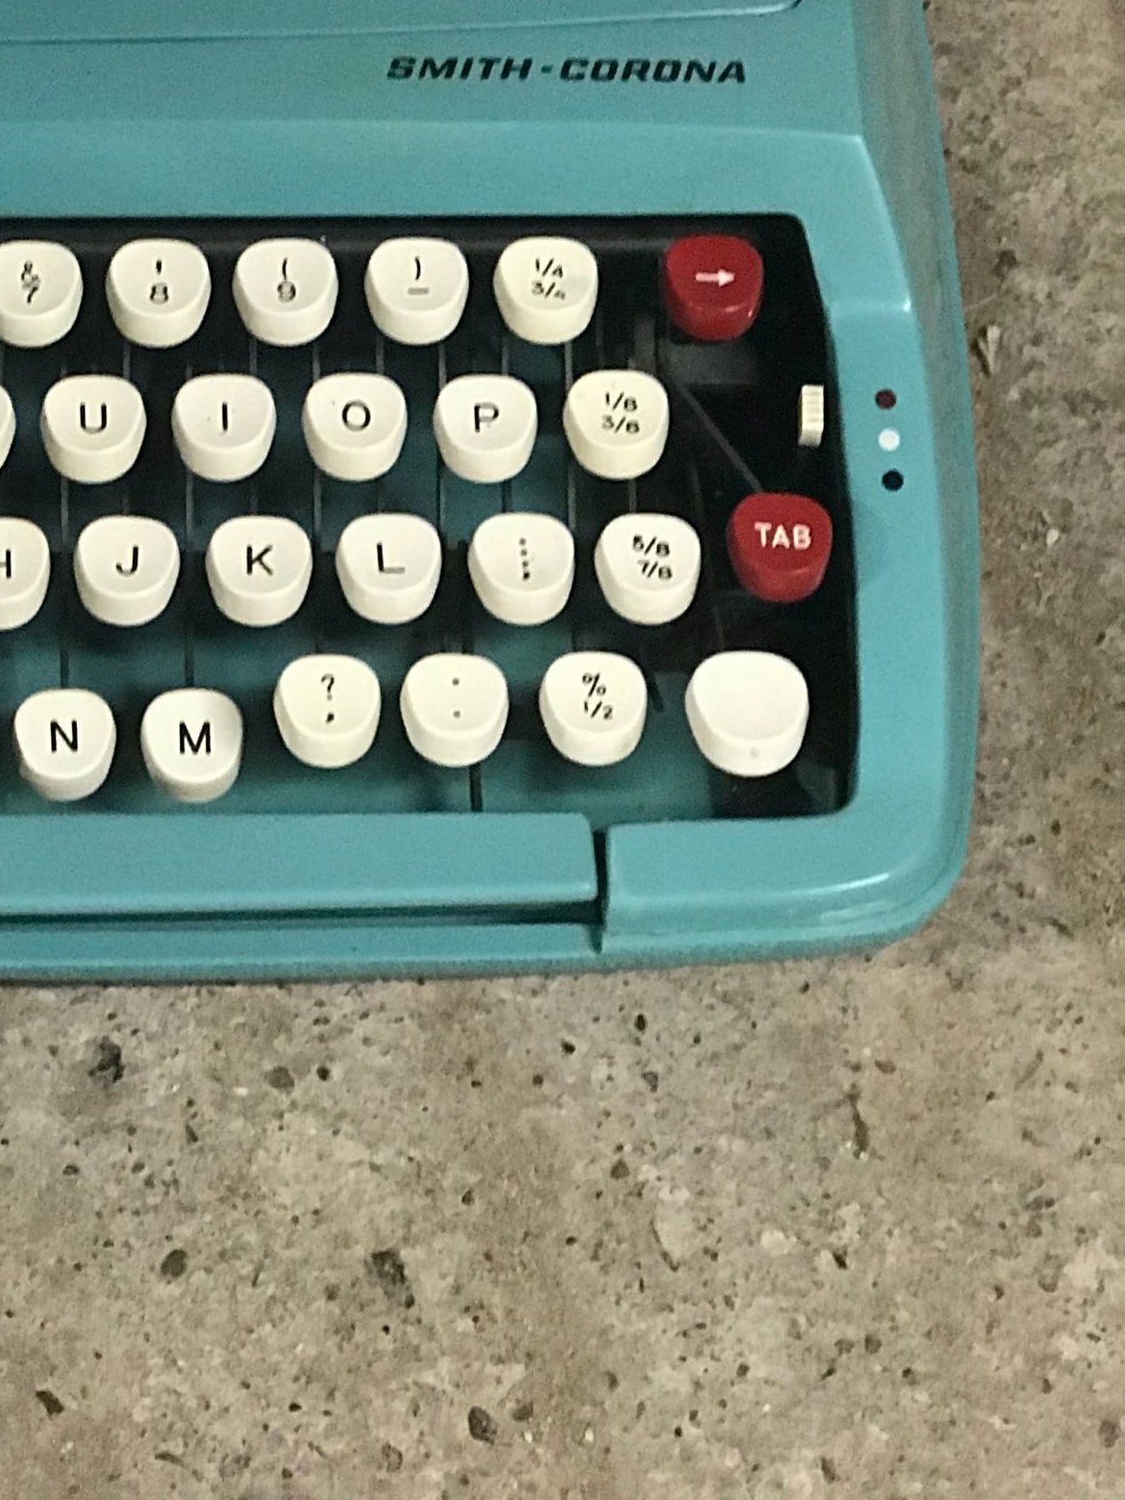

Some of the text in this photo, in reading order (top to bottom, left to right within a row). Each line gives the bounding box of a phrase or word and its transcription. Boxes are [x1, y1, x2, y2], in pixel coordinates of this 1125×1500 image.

[387, 56, 748, 84] SMITH-CORONA
[281, 257, 289, 281] (
[412, 256, 422, 281] )
[535, 258, 564, 278] 1/4
[21, 282, 40, 304] 7
[149, 281, 170, 304] 8
[277, 280, 297, 303] 9
[531, 281, 566, 300] 3/4
[79, 401, 108, 435] U
[221, 401, 229, 434] I
[341, 400, 372, 432] O
[473, 402, 500, 434] P
[755, 521, 812, 550] TAB
[115, 544, 140, 577] J
[245, 544, 274, 577] K
[376, 541, 406, 575] L
[320, 673, 336, 700] ?
[581, 673, 607, 697] %
[583, 701, 614, 721] 1/2
[49, 718, 79, 754] N
[178, 719, 212, 757] M
